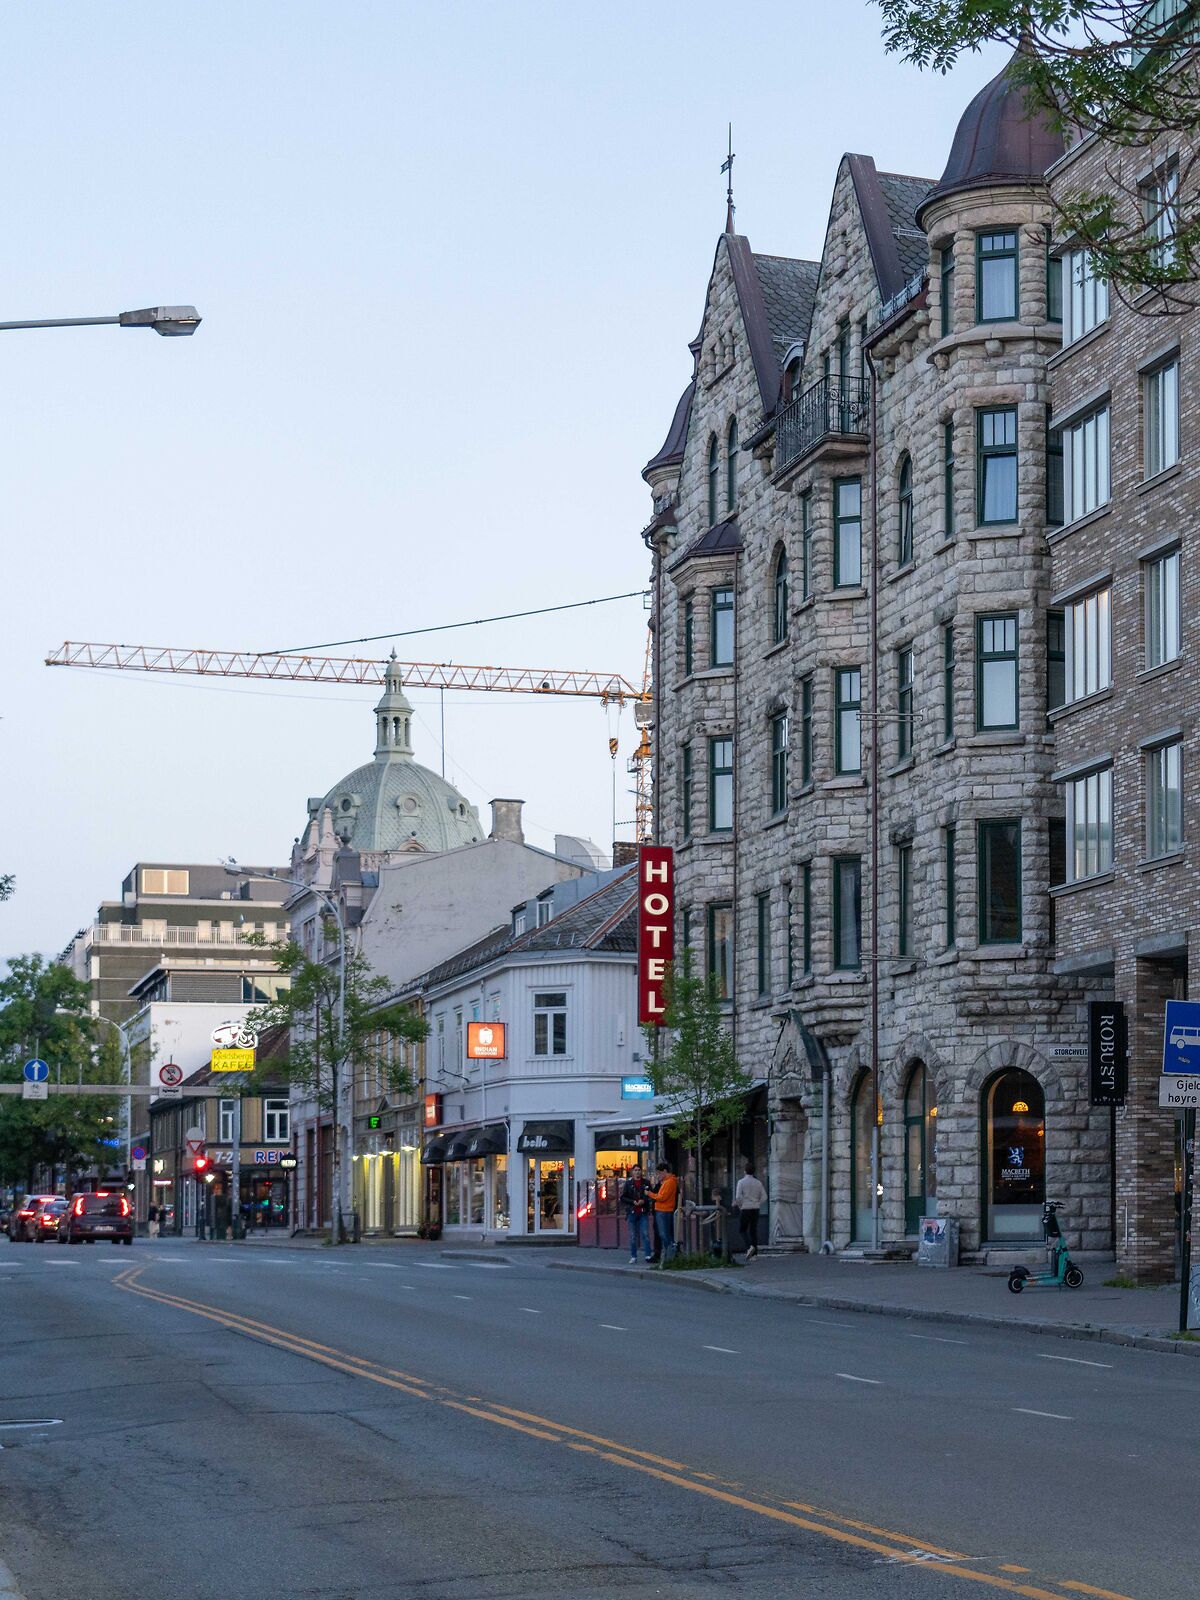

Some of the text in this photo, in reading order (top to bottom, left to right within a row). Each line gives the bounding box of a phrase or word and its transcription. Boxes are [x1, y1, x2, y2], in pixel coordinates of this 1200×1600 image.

[644, 860, 670, 1013] HOTEL
[1100, 1014, 1115, 1090] ROBUST
[1168, 1093, 1197, 1105] høyre
[523, 1136, 548, 1148] bello
[215, 1151, 241, 1163] 7-2
